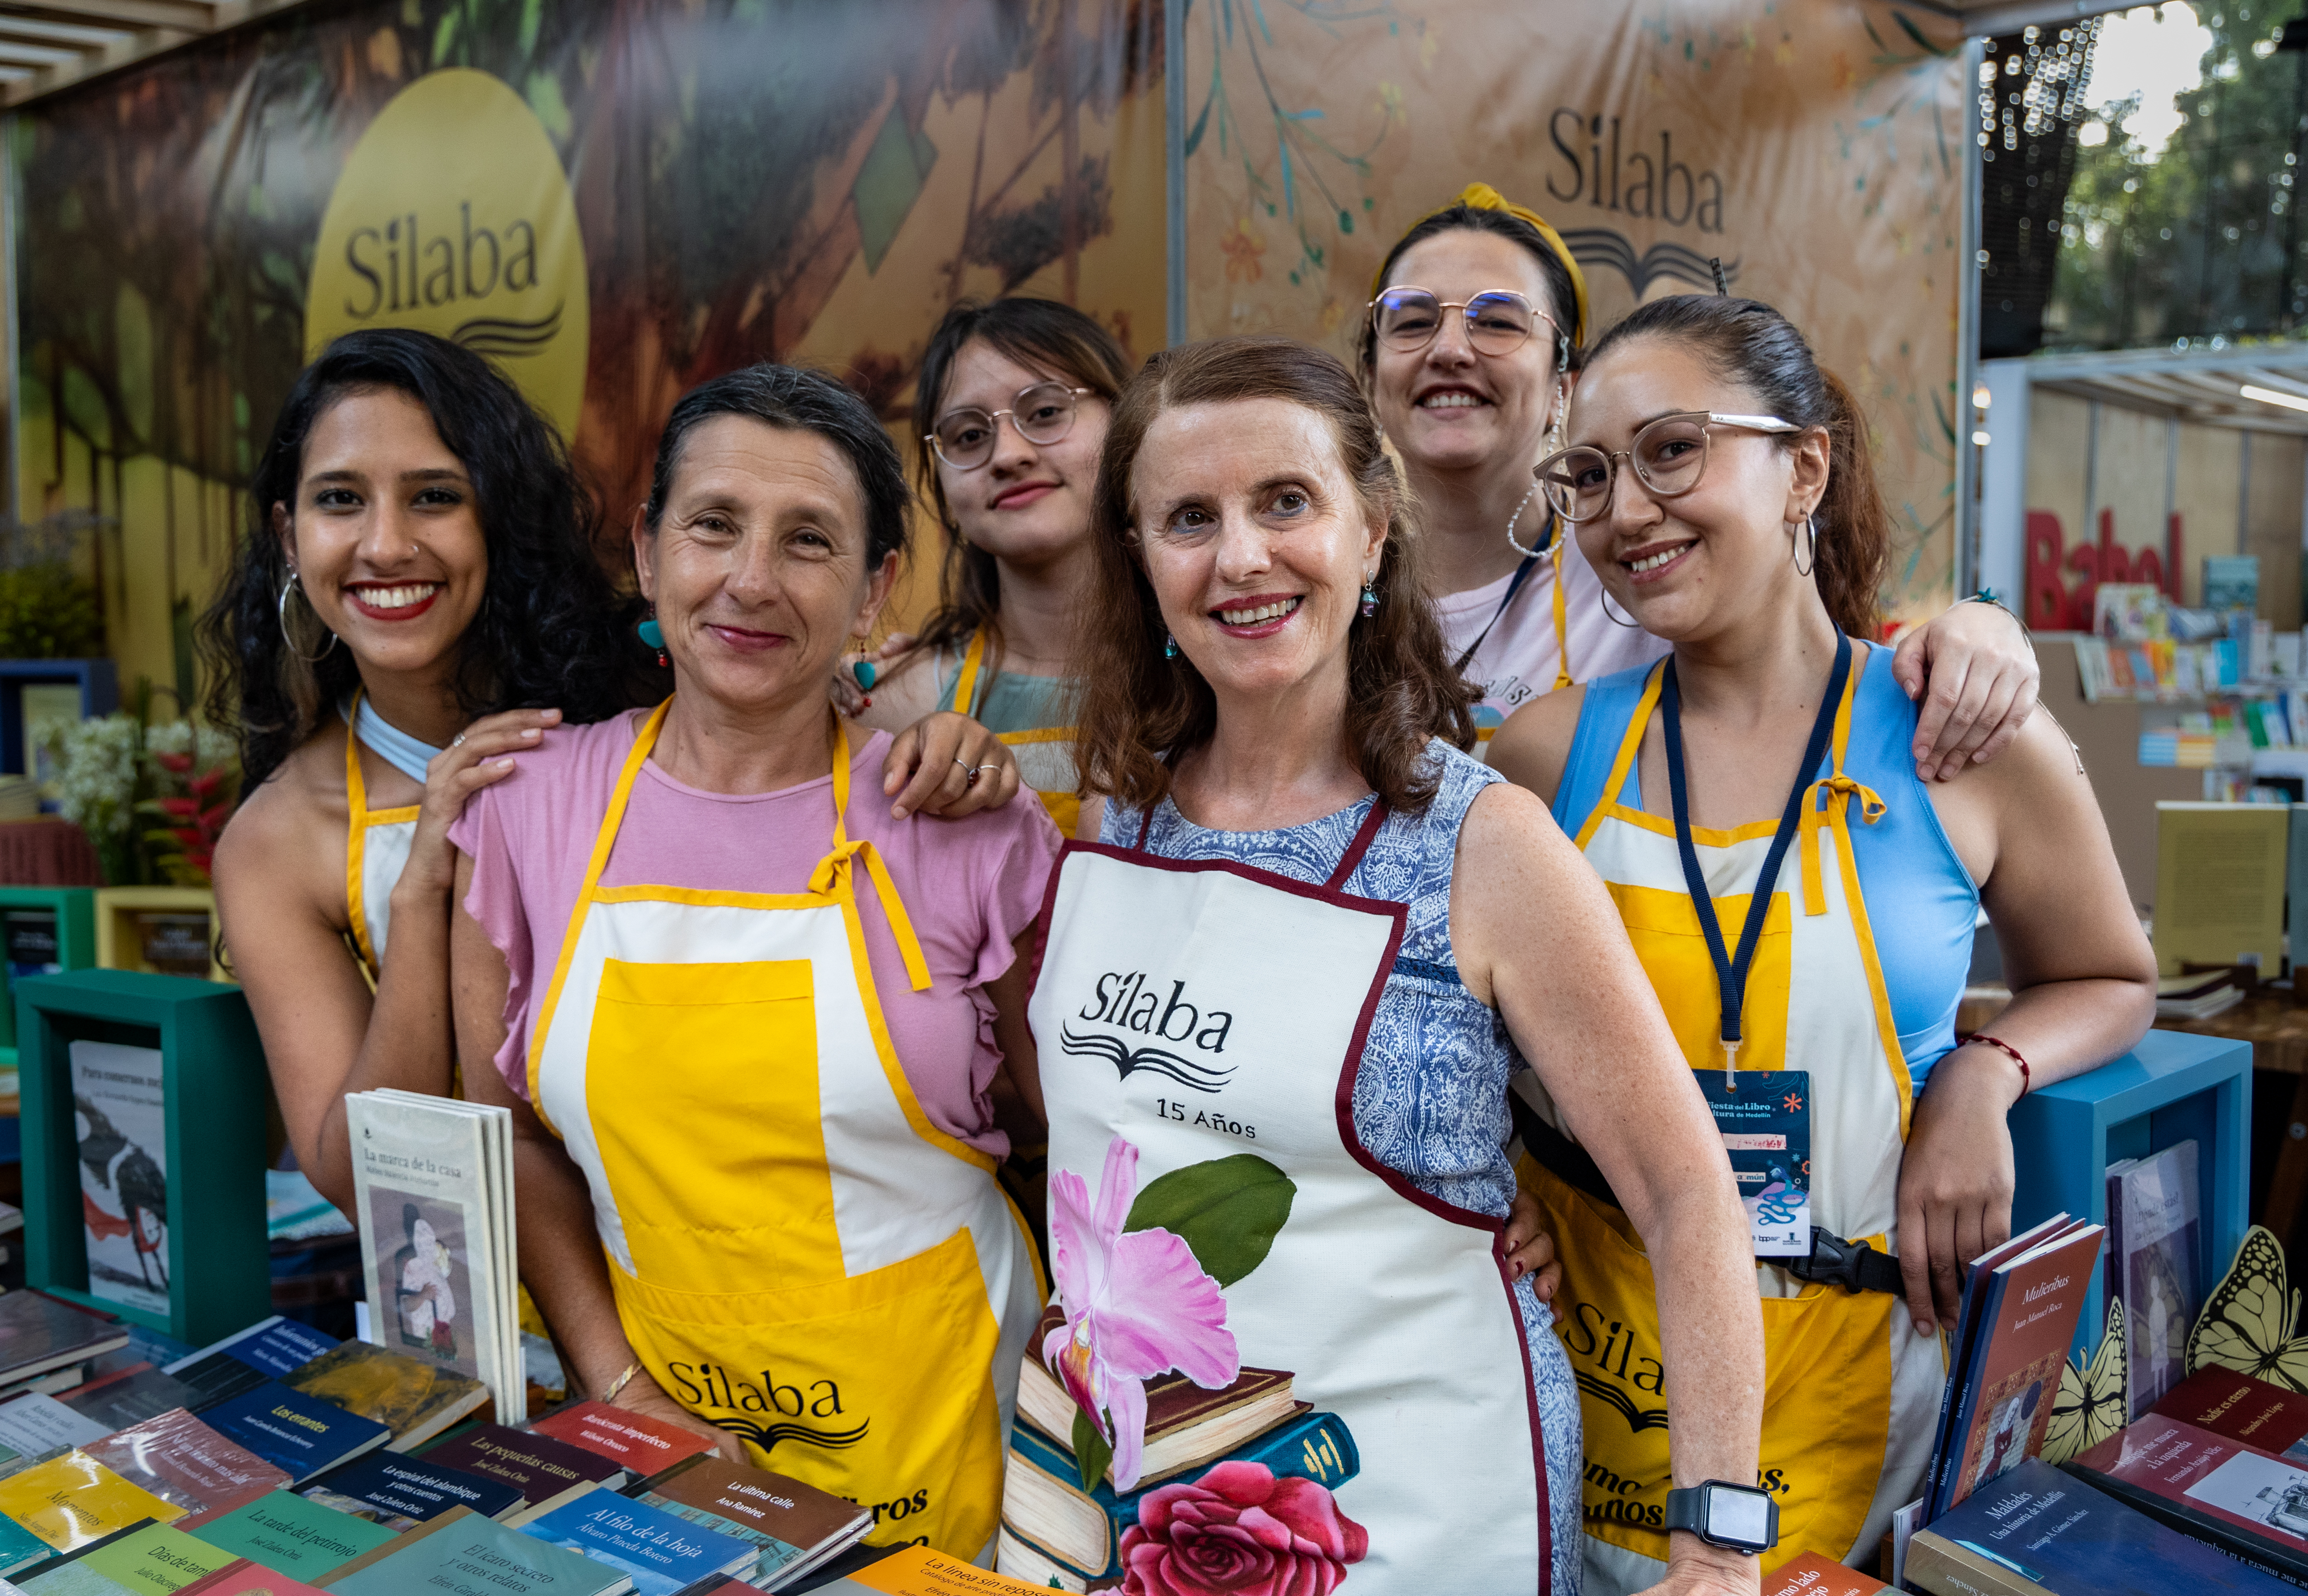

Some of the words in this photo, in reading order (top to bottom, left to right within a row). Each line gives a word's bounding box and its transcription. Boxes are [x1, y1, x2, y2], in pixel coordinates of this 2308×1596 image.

[1156, 1098, 1185, 1121] 15
[1193, 1110, 1256, 1139] Años
[1712, 1110, 1735, 1118] ltura
[1744, 1102, 1771, 1110] Libro
[363, 1147, 376, 1162] La
[378, 1153, 408, 1168] marca
[410, 1155, 424, 1172] de
[426, 1159, 436, 1173] la
[438, 1165, 462, 1178] casa
[2022, 1274, 2070, 1305] Mulieribus
[2012, 1319, 2027, 1333] Juan
[2026, 1305, 2049, 1324] Manuel
[2048, 1302, 2062, 1314] Roca
[1942, 1386, 1951, 1404] Manuel
[1959, 1393, 1967, 1409] Manuel
[2197, 1407, 2225, 1424] Nadie
[2221, 1401, 2232, 1409] es
[2228, 1386, 2251, 1403] eterno
[271, 1404, 294, 1418] Los
[288, 1413, 331, 1433] errantes
[2239, 1419, 2263, 1436] Alejandro
[2257, 1411, 2272, 1423] José
[2266, 1402, 2284, 1414] López
[470, 1437, 494, 1450] Las
[485, 1446, 544, 1467] pequeñas
[541, 1462, 580, 1480] causas
[2114, 1448, 2148, 1468] Aunque
[2143, 1441, 2159, 1451] me
[2157, 1428, 2180, 1444] muera
[2146, 1459, 2164, 1470] la
[2155, 1441, 2193, 1461] izquierda
[470, 1459, 494, 1469] José
[1927, 1453, 1938, 1483] Mulieribus
[1939, 1457, 1952, 1487] Mulieribus
[2163, 1465, 2194, 1484] Fernando
[2188, 1455, 2211, 1468] Araújo
[2202, 1445, 2223, 1456] Vélez
[382, 1465, 397, 1474] La
[393, 1469, 427, 1483] espiral
[419, 1476, 441, 1486] del
[433, 1481, 481, 1500] alambique
[394, 1483, 416, 1493] otros
[412, 1489, 444, 1502] cuentos
[727, 1481, 742, 1491] La
[739, 1485, 771, 1500] última
[770, 1496, 795, 1509] calle
[46, 1490, 104, 1526] Momentos
[247, 1509, 266, 1523] La
[366, 1492, 388, 1501] José
[381, 1496, 407, 1509] Zuleta
[404, 1503, 424, 1514] Ortiz
[715, 1497, 734, 1506] Ana
[731, 1501, 766, 1518] Ramírez
[1985, 1491, 2033, 1519] Maldades
[1989, 1528, 2011, 1539] Una
[2002, 1513, 2033, 1532] historia
[2026, 1507, 2040, 1516] de
[2033, 1490, 2066, 1511] Medellín
[263, 1517, 295, 1533] tarde
[289, 1526, 318, 1540] del
[585, 1509, 617, 1522] Al
[605, 1514, 634, 1531] filo
[631, 1525, 655, 1539] de
[650, 1531, 670, 1545] la
[665, 1538, 703, 1558] hoja
[2026, 1535, 2051, 1551] Santiago
[2051, 1520, 2073, 1534] Gómez
[2067, 1509, 2089, 1523] Sánchez
[245, 1535, 266, 1546] José
[261, 1541, 284, 1553] Zuleta
[283, 1548, 303, 1560] Ortiz
[301, 1535, 357, 1557] petirrojo
[575, 1522, 608, 1539] Álvaro
[606, 1534, 641, 1551] Pineda
[638, 1546, 673, 1563] Botero
[148, 1546, 176, 1562] Días
[169, 1557, 188, 1568] de
[462, 1543, 488, 1557] El
[477, 1550, 511, 1567] ícaro
[508, 1563, 555, 1583] secreto
[2248, 1559, 2279, 1577] muera
[134, 1567, 154, 1578] Julio
[427, 1575, 455, 1589] Efrén
[438, 1558, 460, 1567] y
[456, 1562, 491, 1577] otros
[486, 1574, 531, 1593] relatos
[920, 1568, 955, 1584] Catálogo
[964, 1584, 983, 1592] arte
[925, 1558, 944, 1570] La
[943, 1565, 978, 1582] línea
[977, 1577, 1001, 1588] sin
[1788, 1570, 1821, 1587] lado
[1946, 1574, 1979, 1596] Sánchez
[2281, 1573, 2297, 1584] me
[924, 1586, 950, 1596] Efrén
